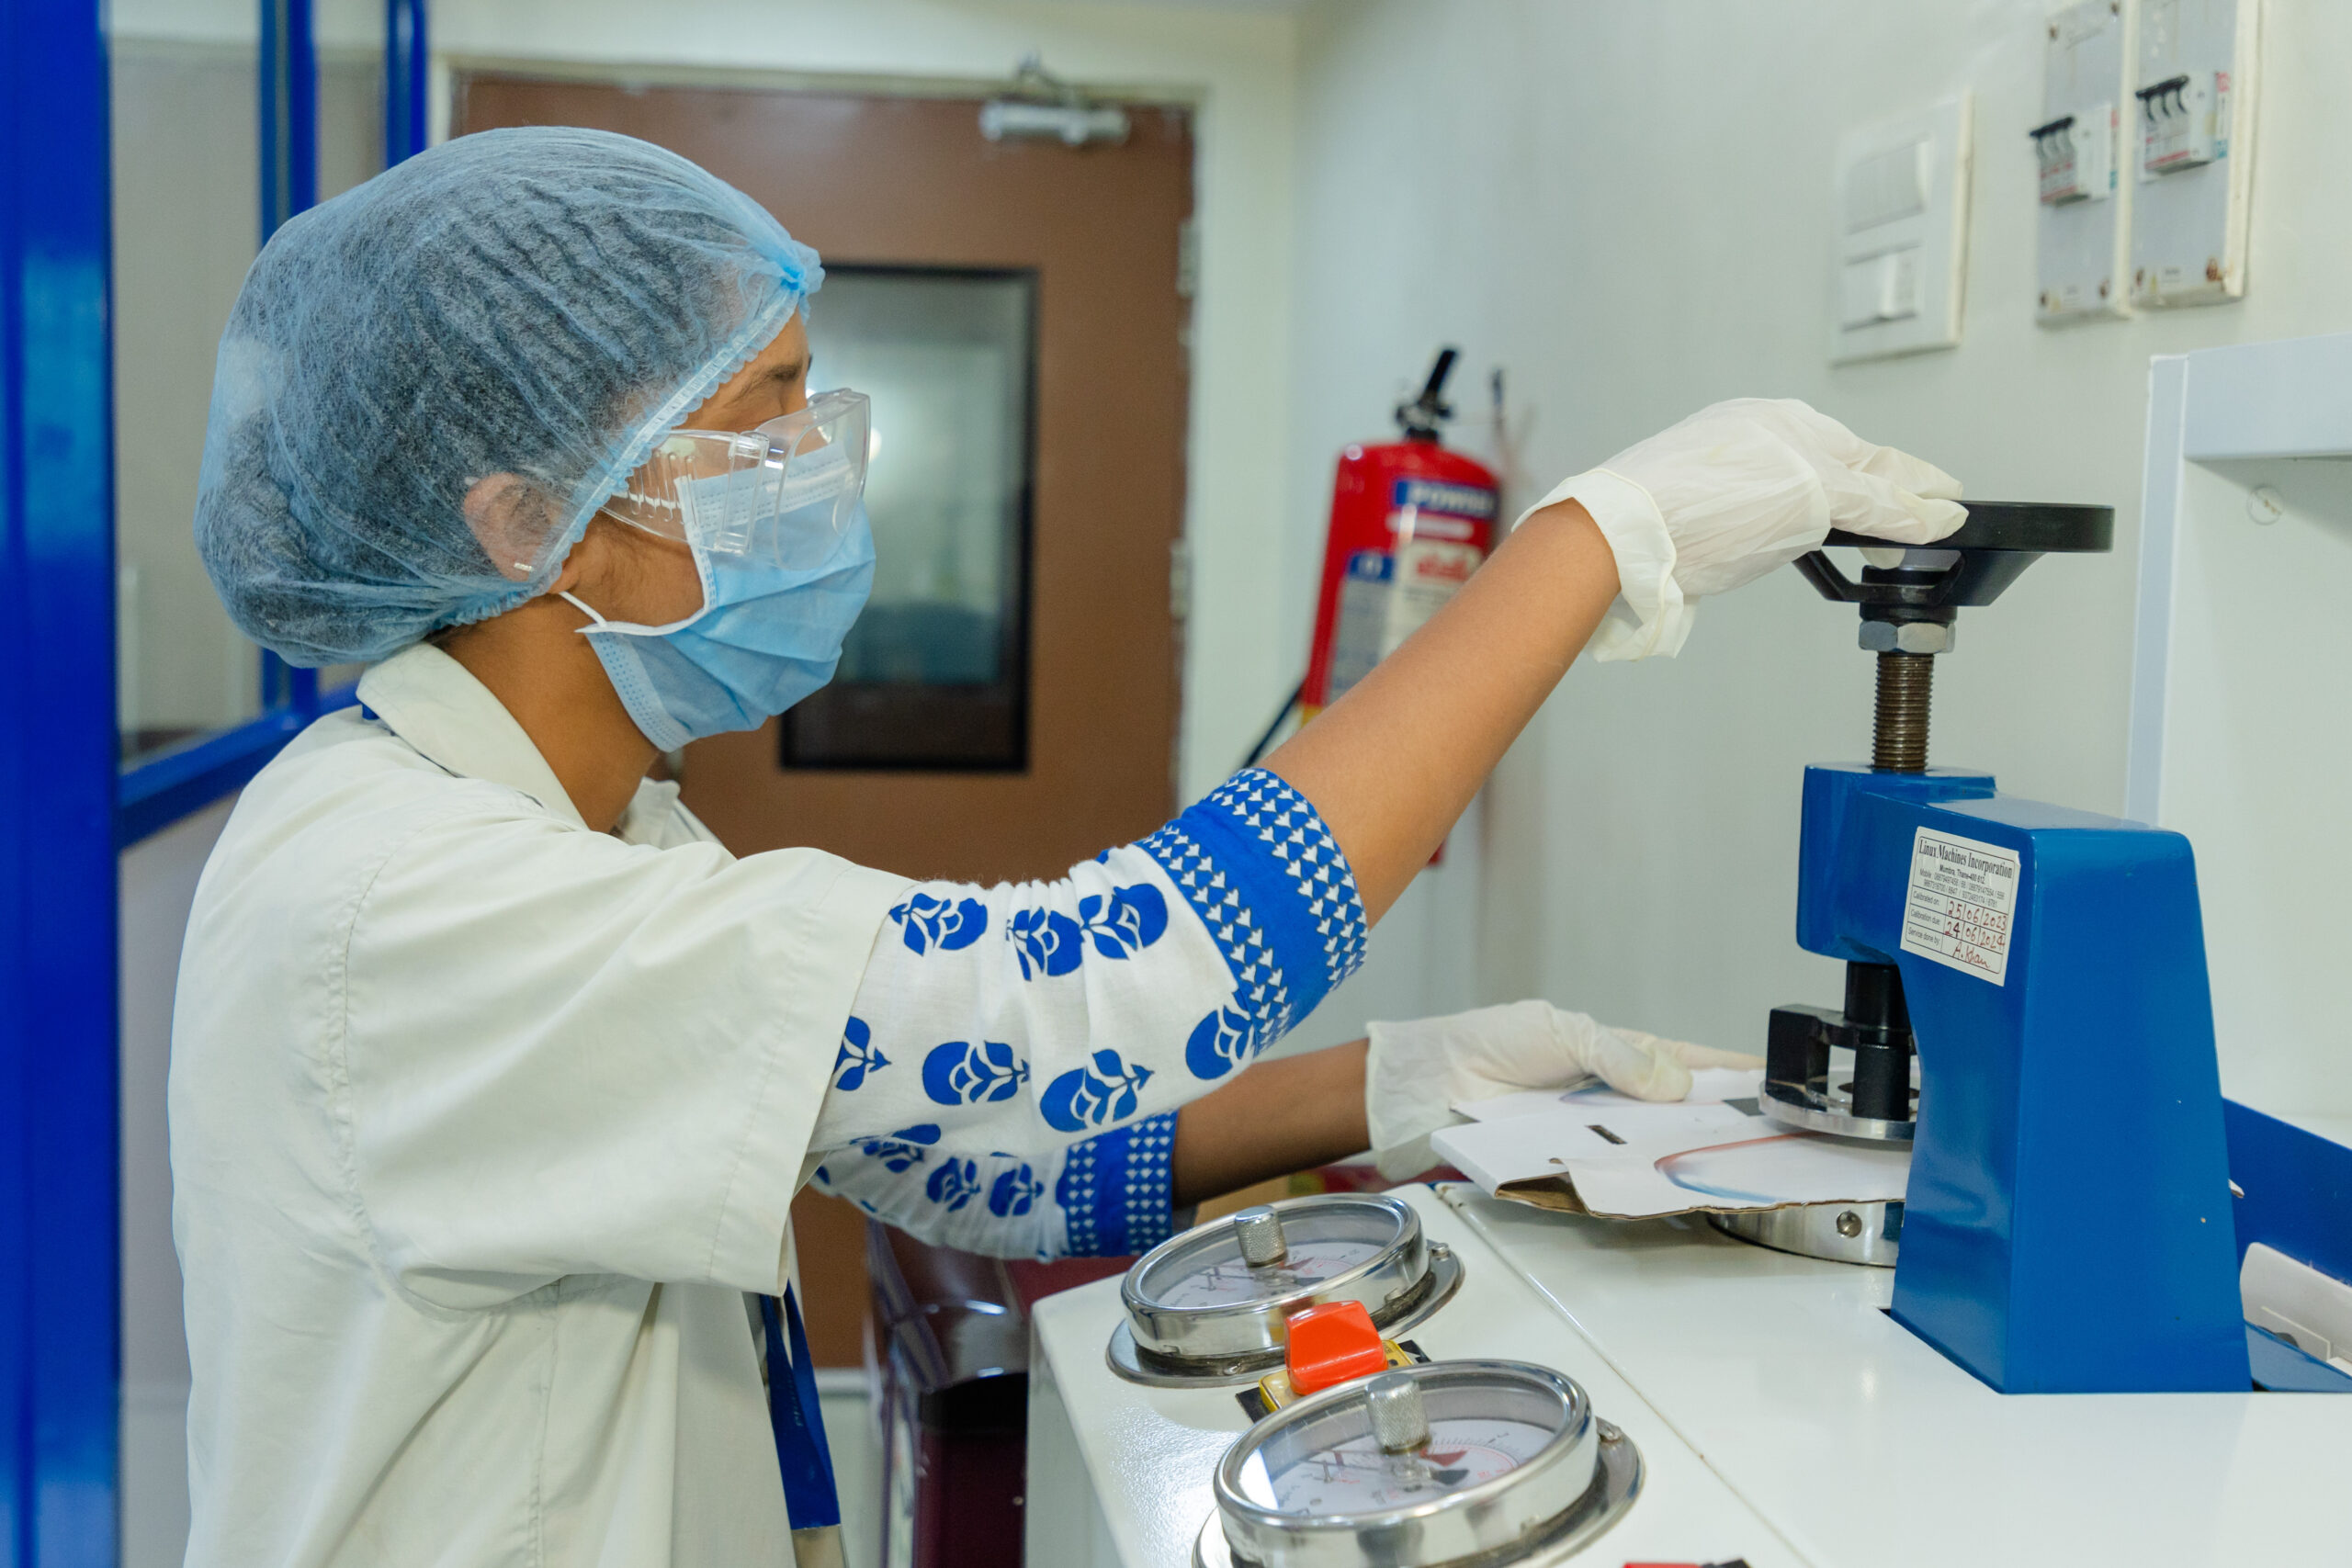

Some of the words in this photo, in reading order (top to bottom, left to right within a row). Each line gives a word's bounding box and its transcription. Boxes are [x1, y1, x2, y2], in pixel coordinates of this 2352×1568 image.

[1918, 840, 1937, 856] Linux
[1938, 844, 1966, 865] Machines
[1968, 852, 2012, 878] Incorporation
